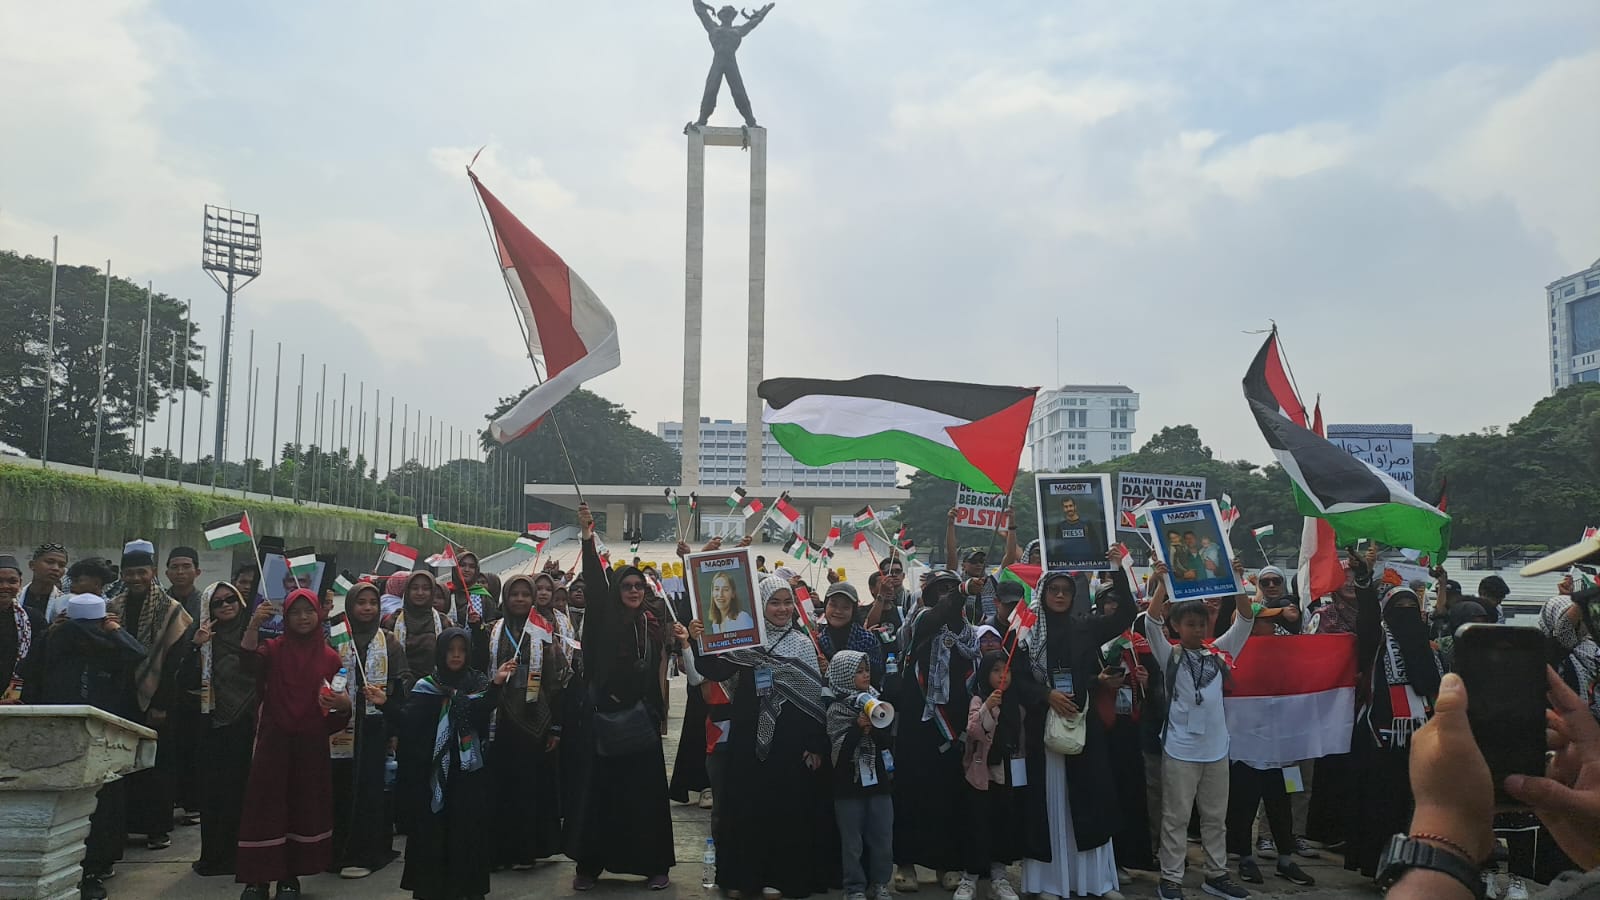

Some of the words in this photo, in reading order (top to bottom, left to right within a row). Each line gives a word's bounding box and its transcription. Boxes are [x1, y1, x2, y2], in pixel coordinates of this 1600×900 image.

[1122, 476, 1161, 485] HATI-HATI
[1175, 480, 1202, 488] JALAN
[1122, 484, 1153, 496] DAN
[1157, 486, 1202, 500] INGAT
